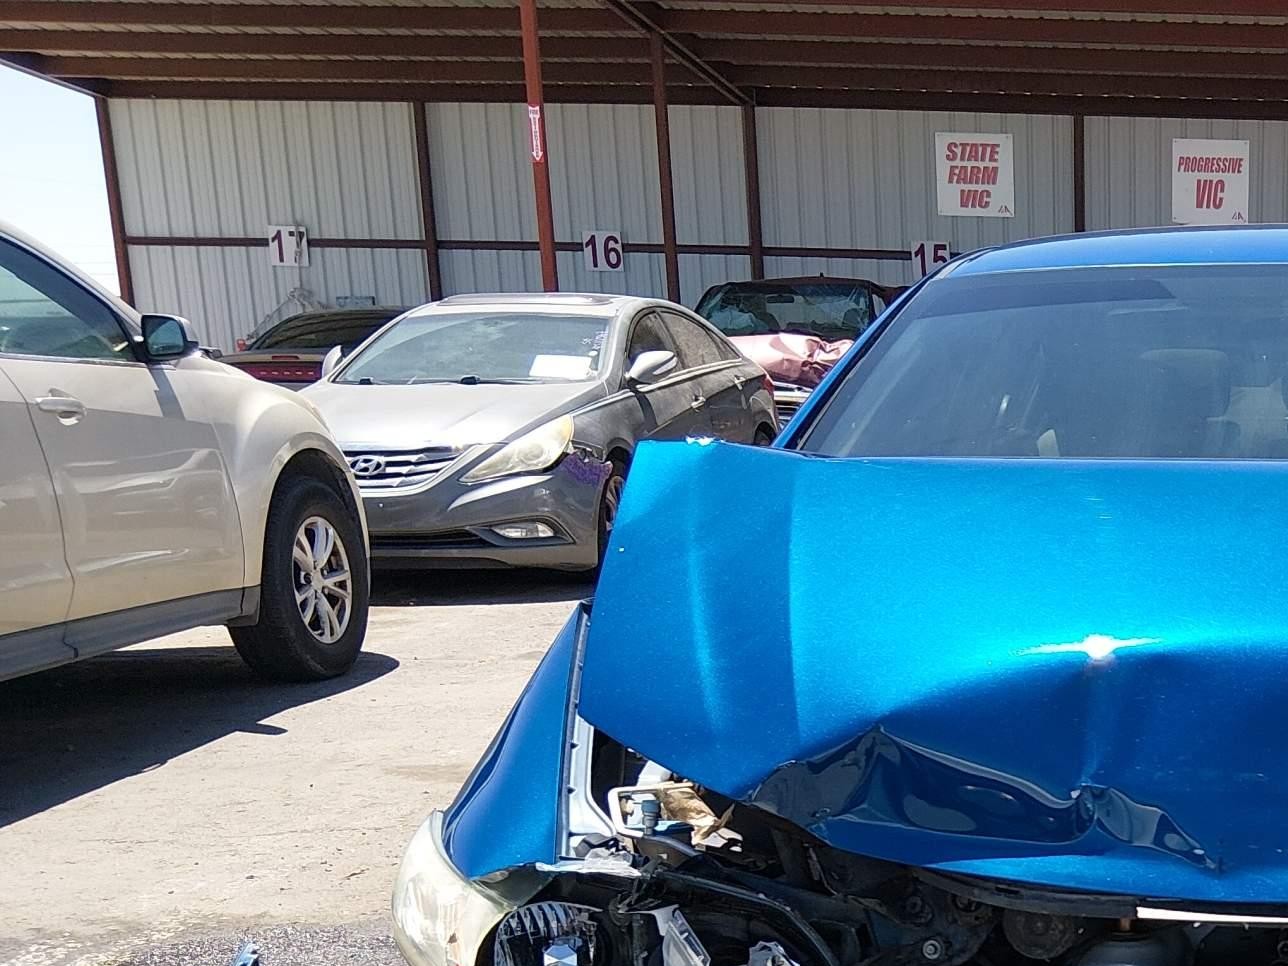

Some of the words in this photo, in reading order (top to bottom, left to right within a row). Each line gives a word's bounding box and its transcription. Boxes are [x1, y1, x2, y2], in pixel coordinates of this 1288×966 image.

[946, 142, 1000, 162] STATE
[947, 165, 999, 185] FARM
[1177, 156, 1244, 174] PROGRESSIVE
[960, 189, 992, 208] VIC
[1196, 179, 1225, 209] VIC
[271, 230, 305, 263] 17
[585, 234, 622, 269] 16
[914, 243, 948, 279] 15
